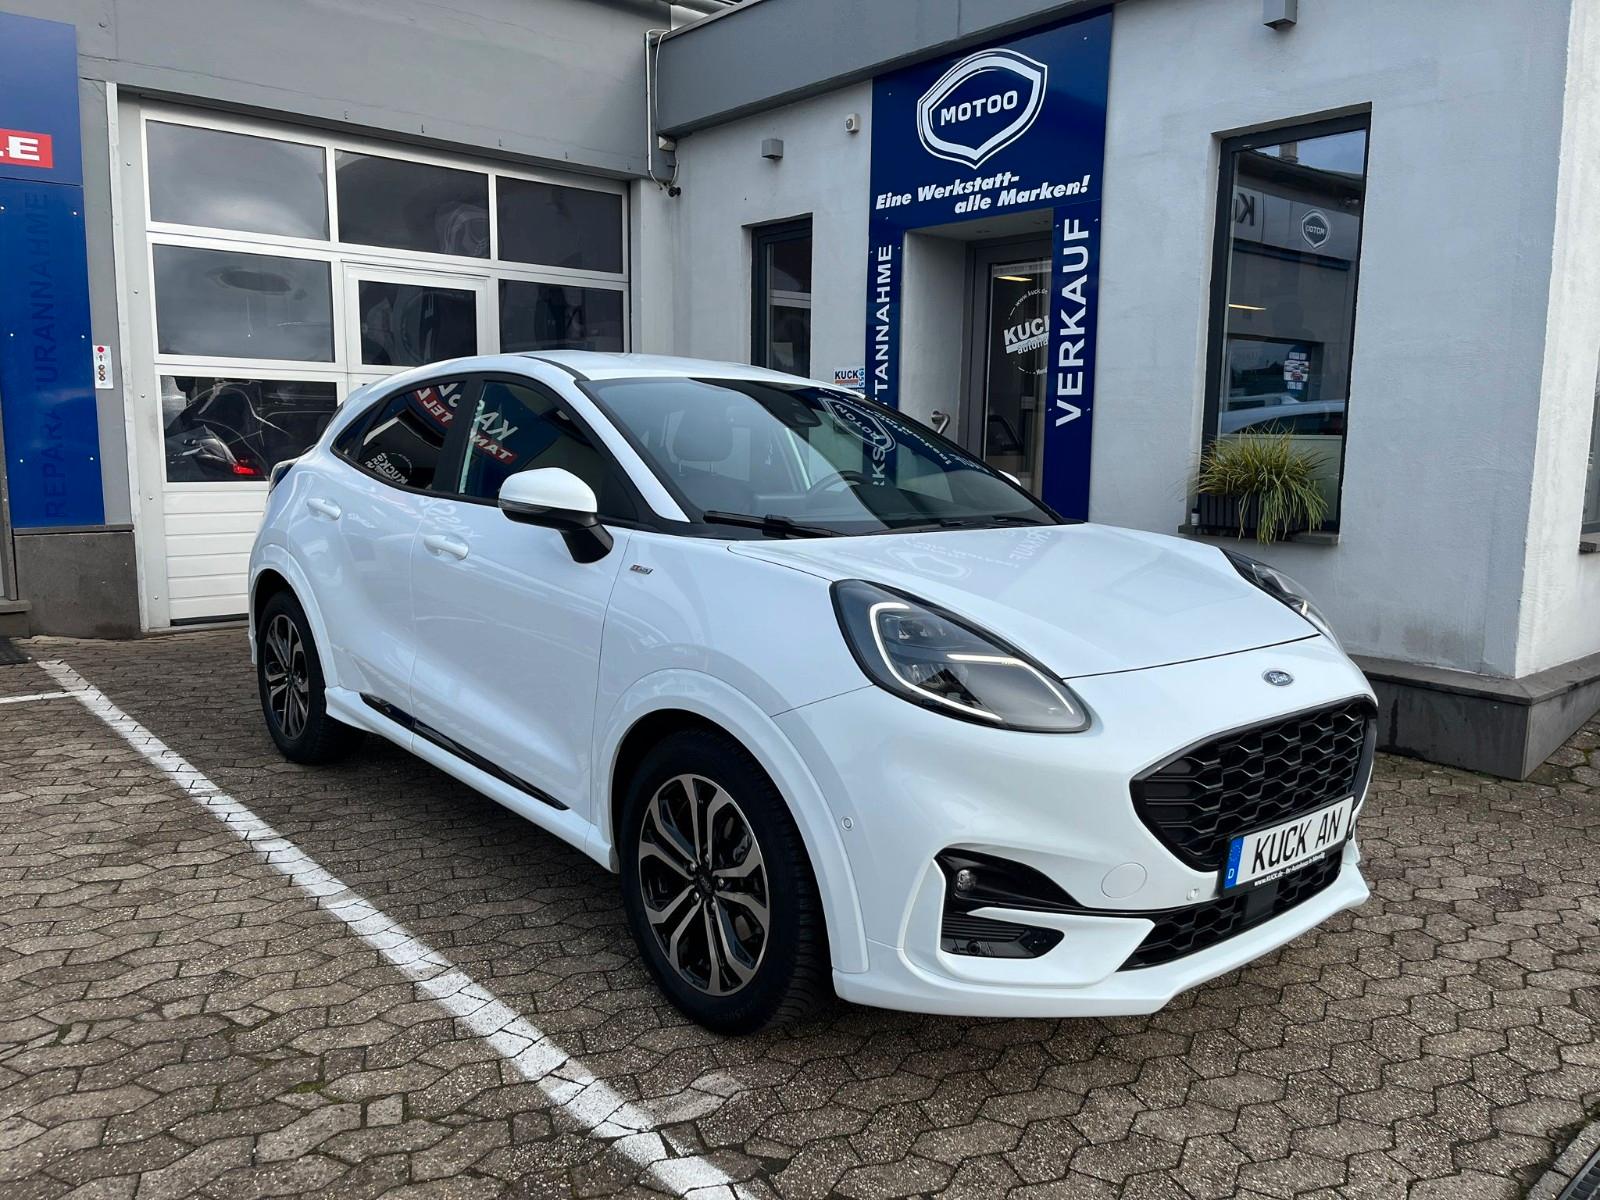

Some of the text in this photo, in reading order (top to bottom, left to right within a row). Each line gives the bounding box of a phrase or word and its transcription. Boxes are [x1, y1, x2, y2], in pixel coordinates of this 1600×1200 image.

[940, 90, 1018, 126] MOTOO
[875, 171, 1020, 210] Eine Werkstatt-
[954, 175, 1090, 214] alle Marken!
[1055, 218, 1090, 427] VERKAUF
[834, 369, 859, 380] KUCK
[1251, 818, 1312, 874] KUCK
[1315, 807, 1343, 849] AN
[1227, 868, 1235, 880] D
